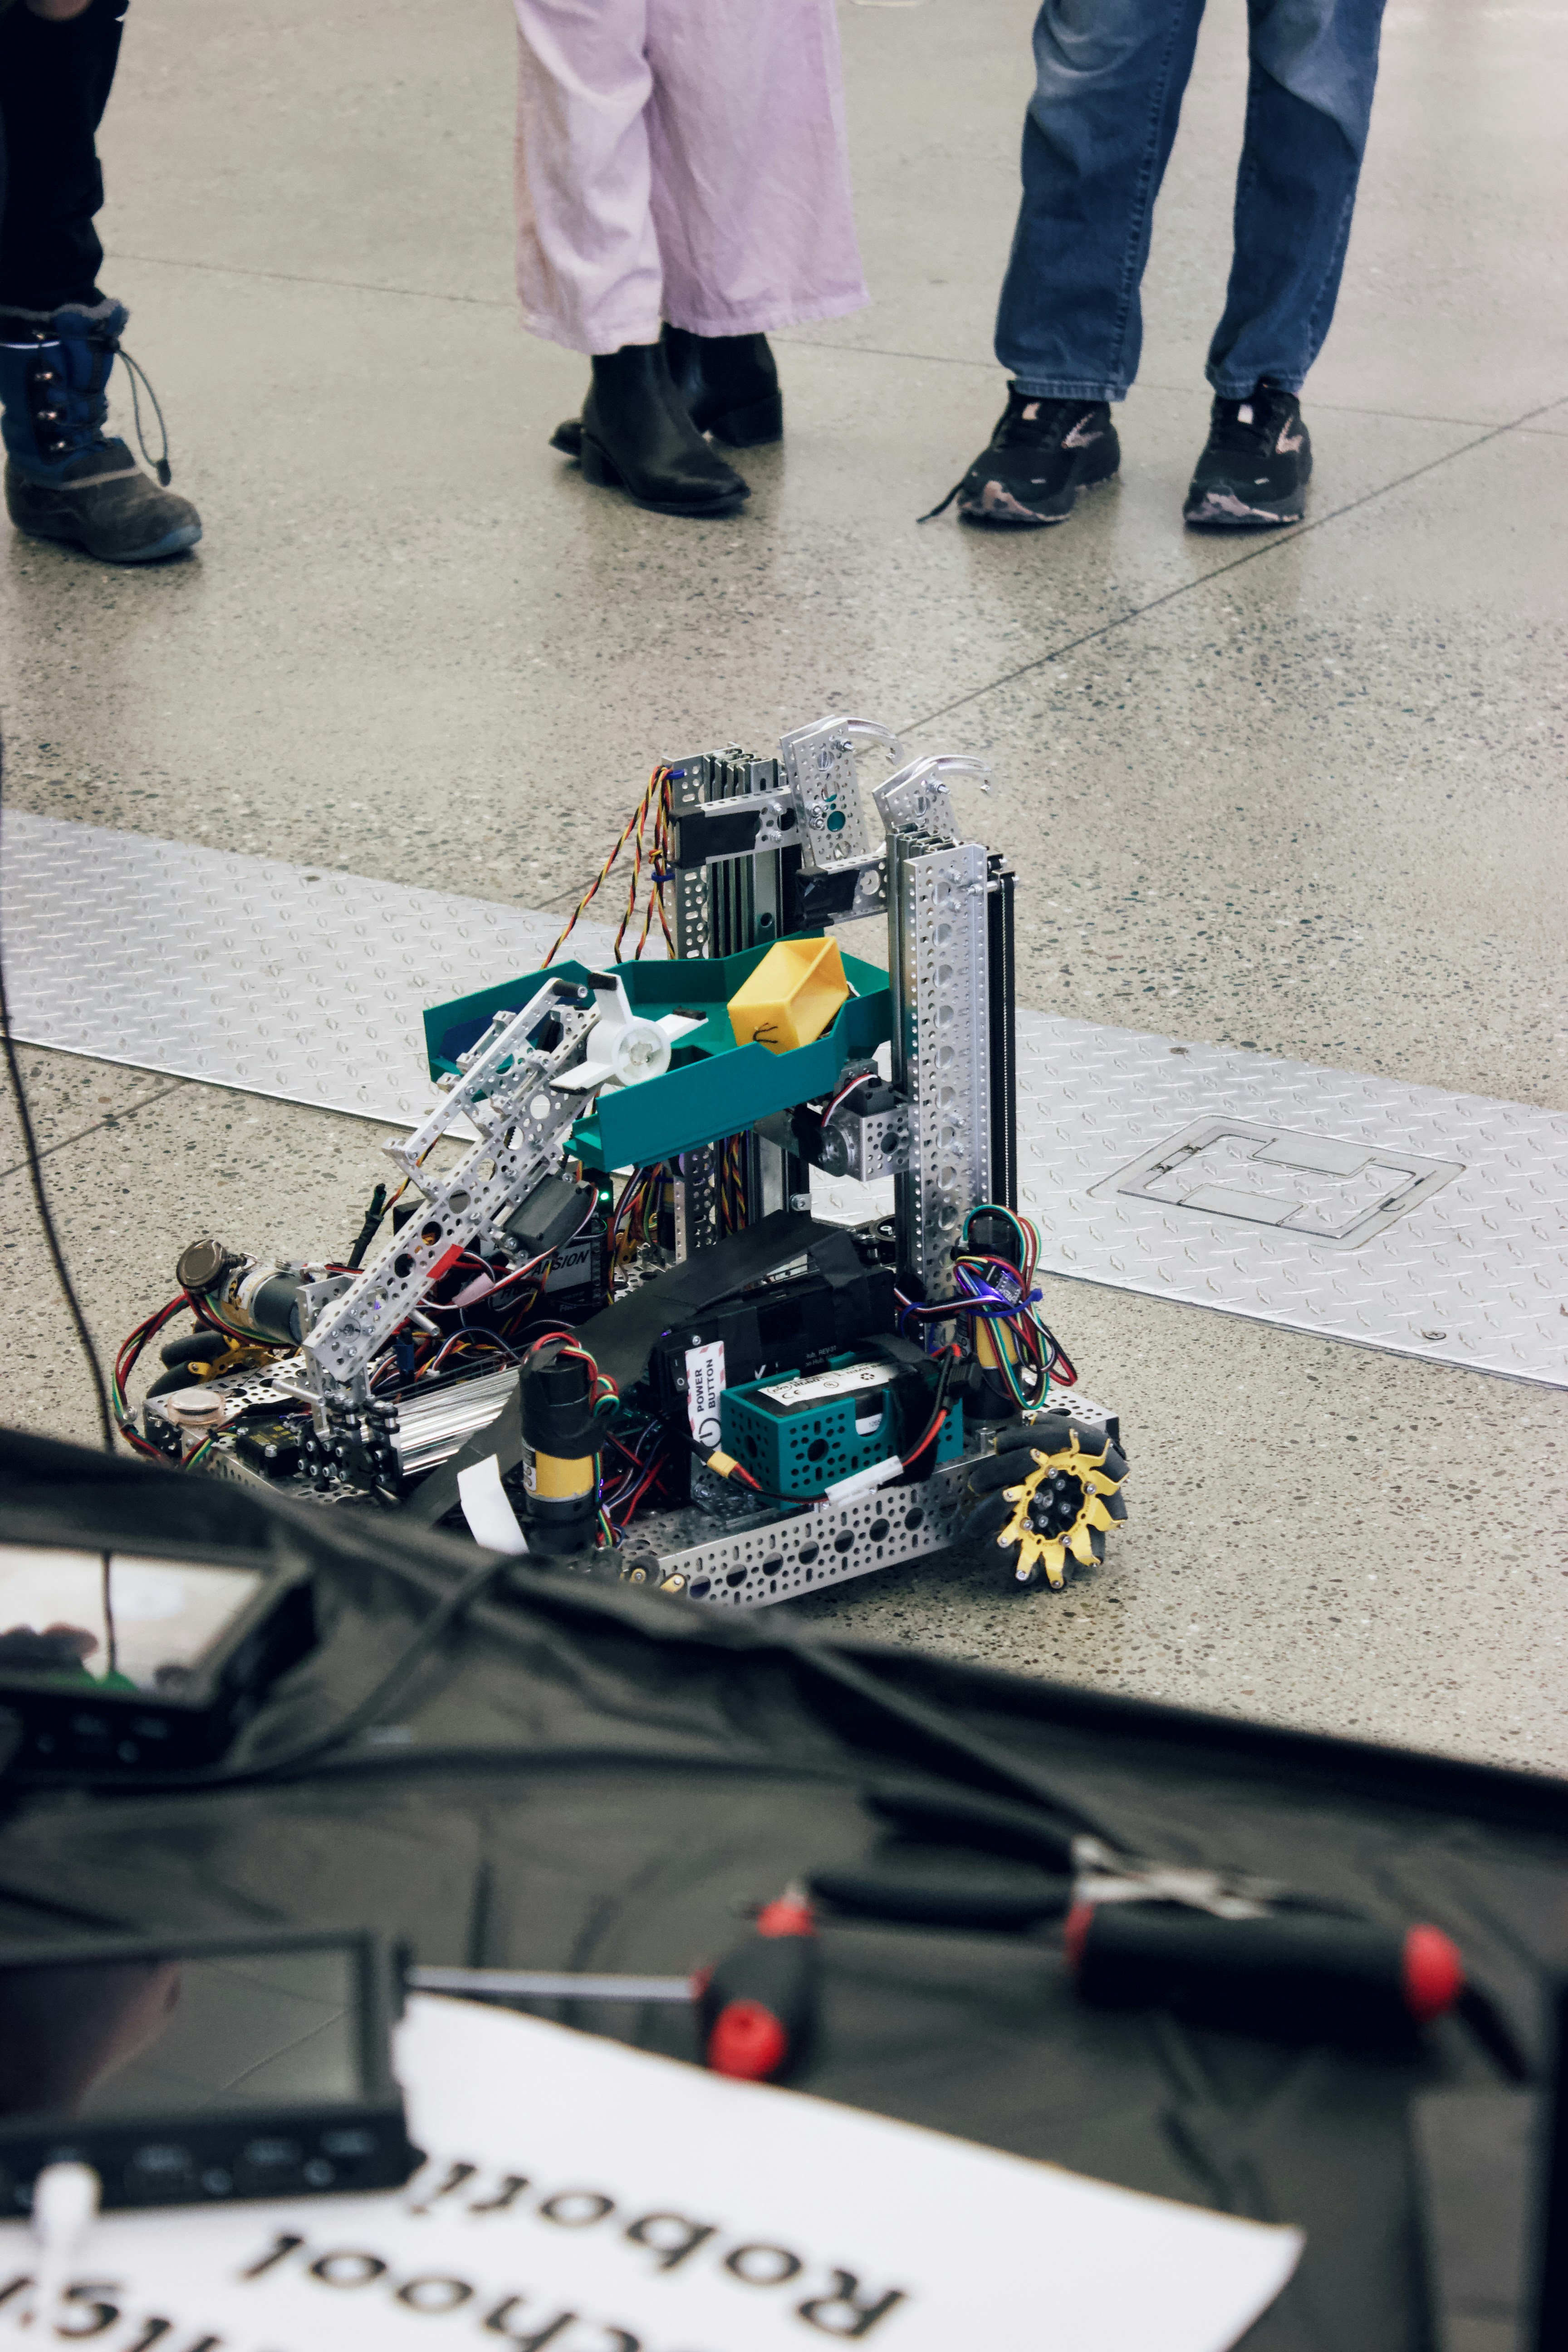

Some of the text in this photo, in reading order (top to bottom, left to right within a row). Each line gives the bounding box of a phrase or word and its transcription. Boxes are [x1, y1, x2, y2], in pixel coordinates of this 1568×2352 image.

[695, 1368, 704, 1412] POWER
[706, 1359, 716, 1409] BUTTON
[241, 2228, 644, 2352] chool
[410, 2160, 908, 2342] Roboti
